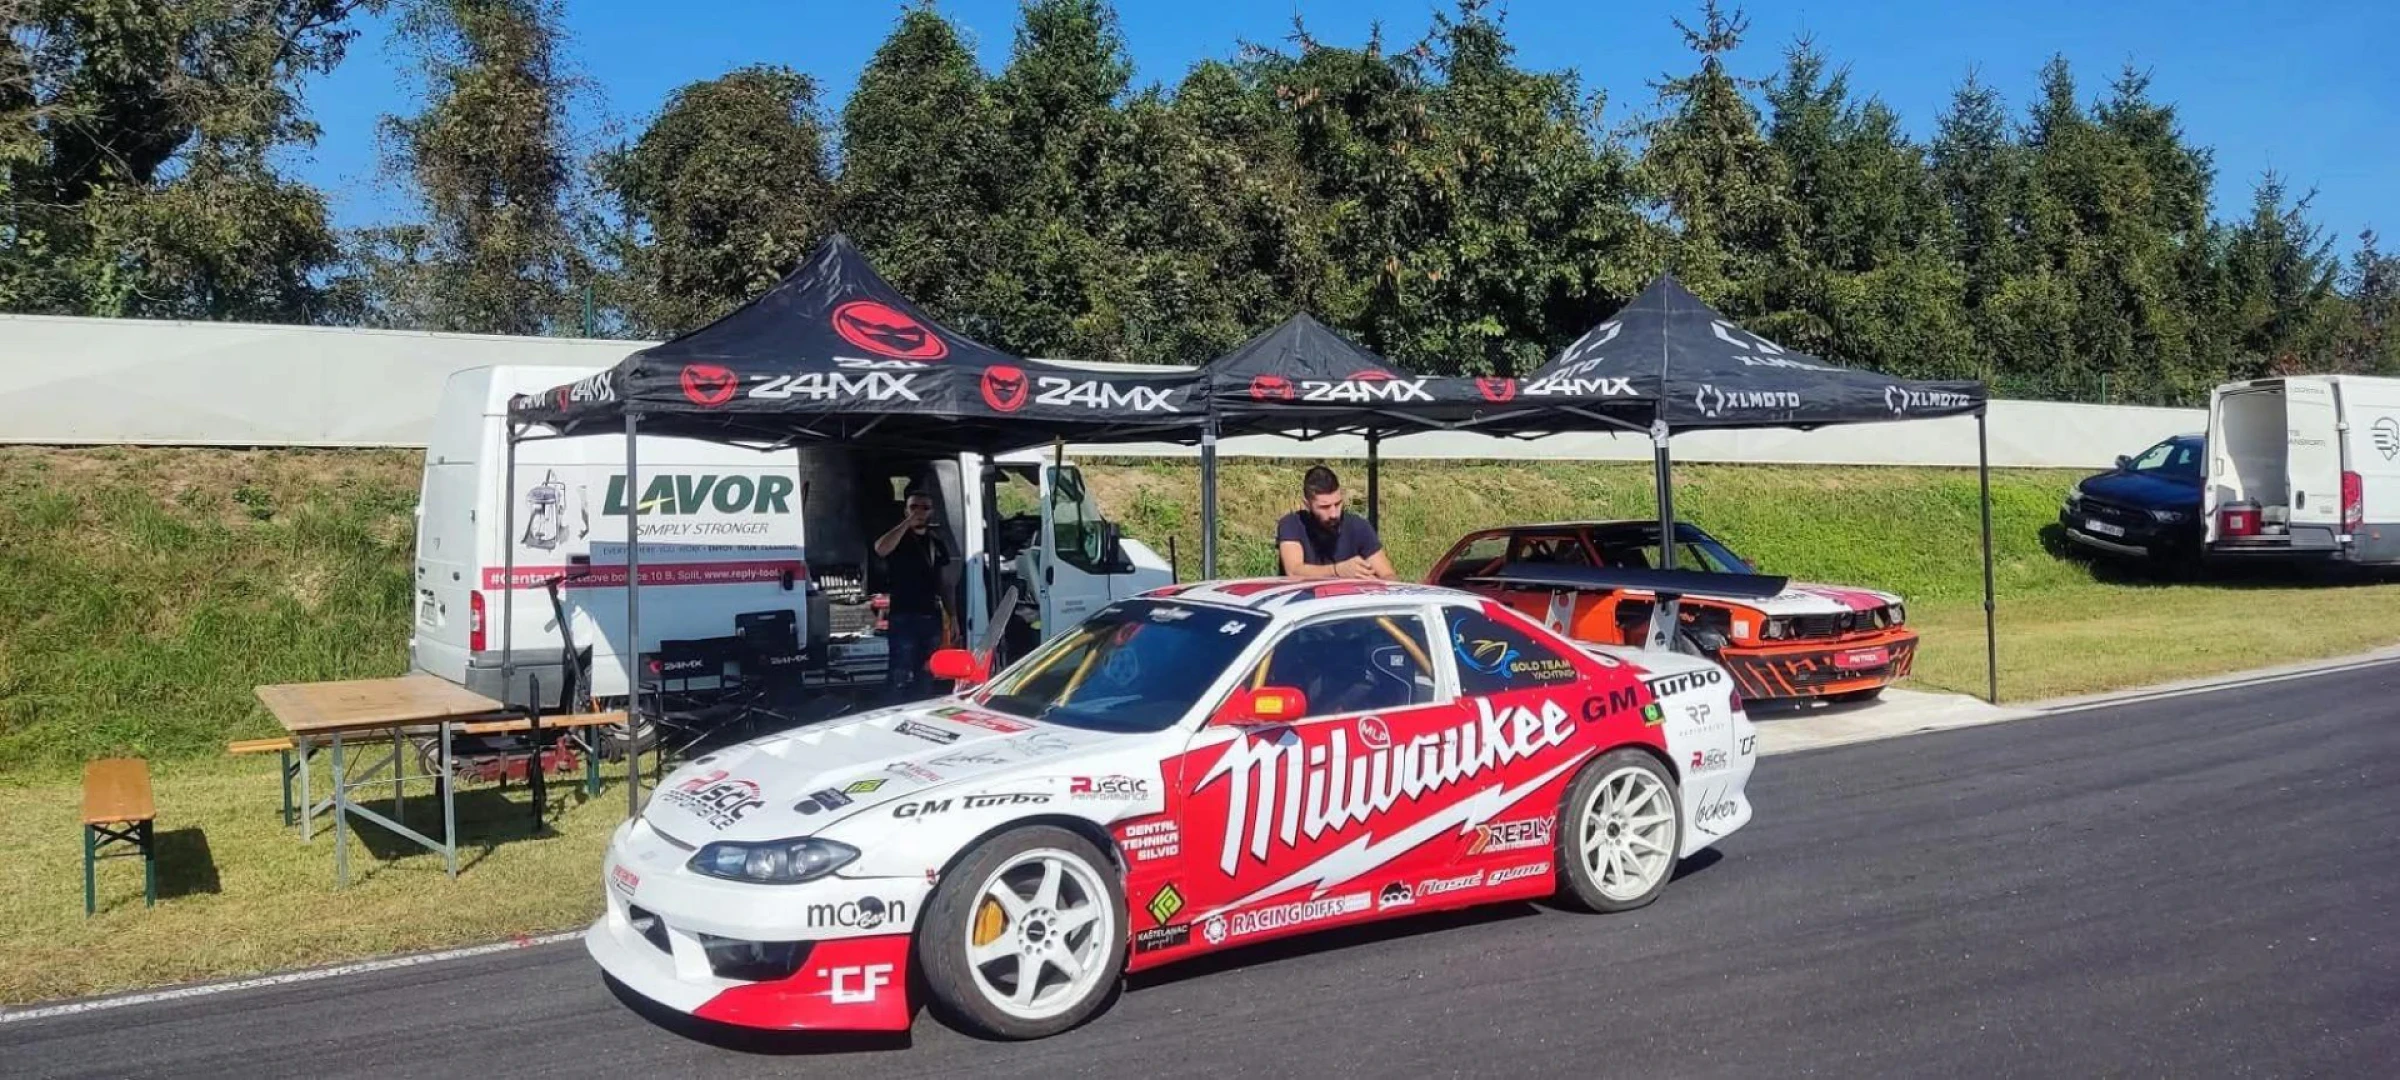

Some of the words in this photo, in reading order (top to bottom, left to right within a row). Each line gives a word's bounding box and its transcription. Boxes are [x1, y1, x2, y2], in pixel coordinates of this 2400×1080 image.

[749, 371, 921, 401] 24MX
[1034, 376, 1181, 413] 24MX
[1302, 378, 1435, 402] 24MX
[1523, 377, 1640, 396] 24MX
[602, 474, 794, 516] LAVOR
[636, 522, 692, 536] SIMPLY
[693, 521, 770, 535] STRONGER
[1510, 661, 1540, 673] GOLD
[1540, 659, 1571, 670] TEAM
[1582, 685, 1639, 723] GM
[1643, 667, 1722, 699] Turbo
[1195, 696, 1577, 878] Milwaukee
[892, 797, 953, 820] GM
[963, 793, 1054, 809] Turbo
[1125, 820, 1178, 837] DENTAL
[1490, 815, 1556, 846] REPLY
[1121, 832, 1179, 851] TEHNIKA
[1137, 845, 1179, 862] SILVIO
[1231, 907, 1301, 936] RACING
[1302, 897, 1347, 920] DIFFS
